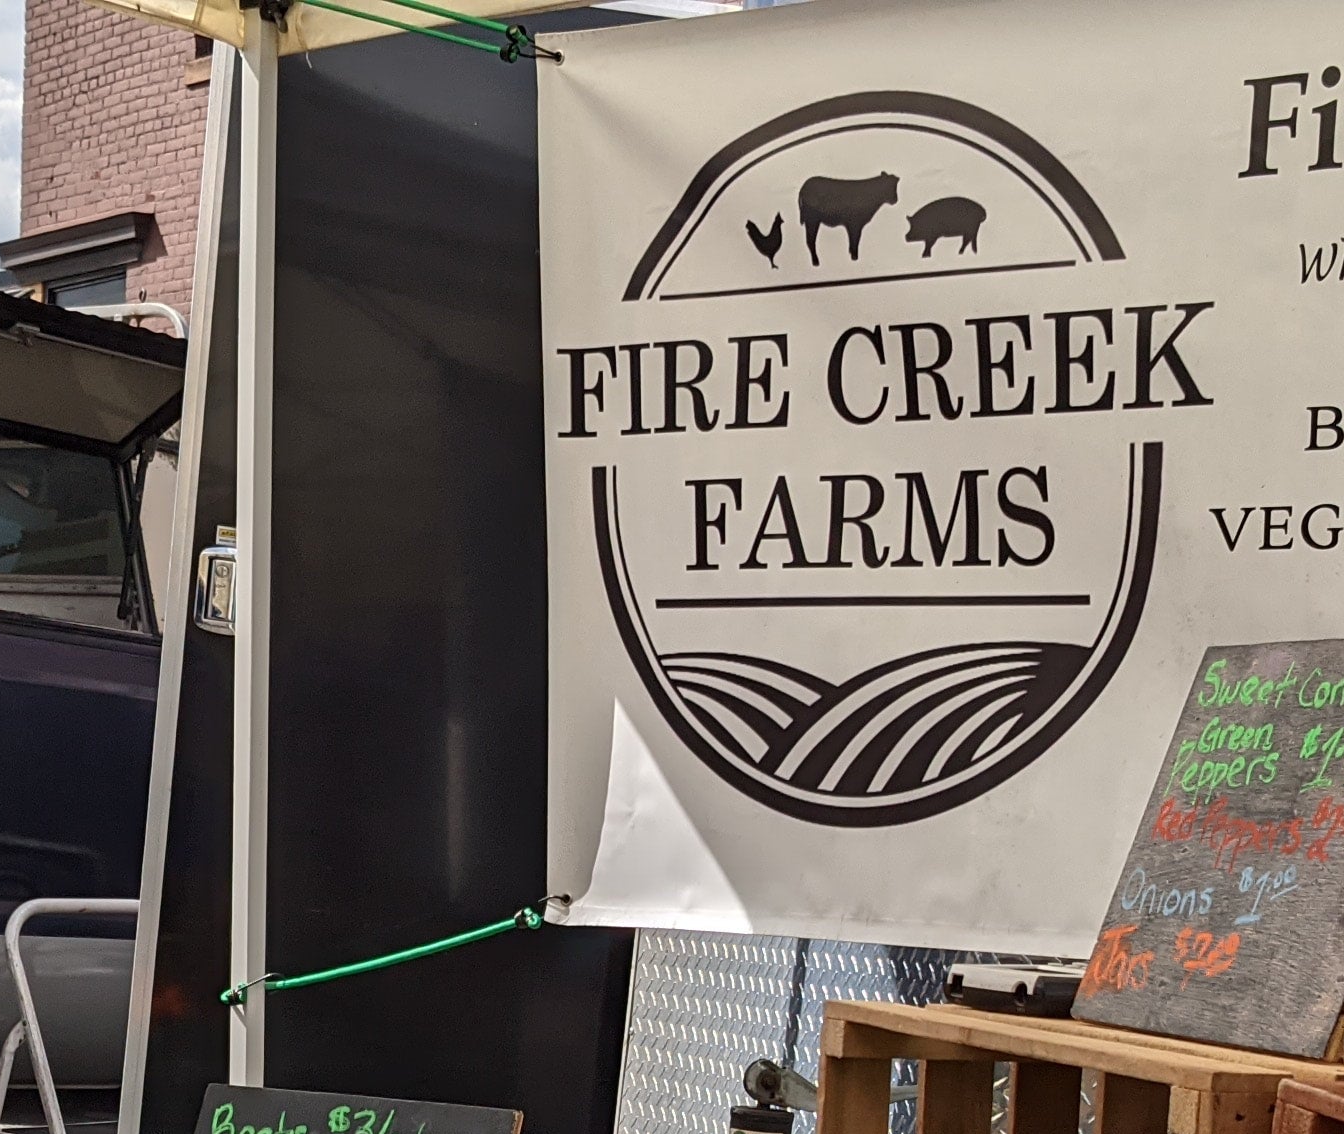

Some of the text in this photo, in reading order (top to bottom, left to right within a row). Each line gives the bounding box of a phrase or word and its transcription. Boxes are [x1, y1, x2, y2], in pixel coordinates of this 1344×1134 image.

[557, 302, 1216, 439] FIRE CREEK
[685, 464, 1056, 571] FARMS
[1198, 658, 1297, 709] Sweet
[1197, 716, 1275, 754] Green
[1164, 739, 1281, 806] Peppers
[1121, 868, 1215, 917] Onions
